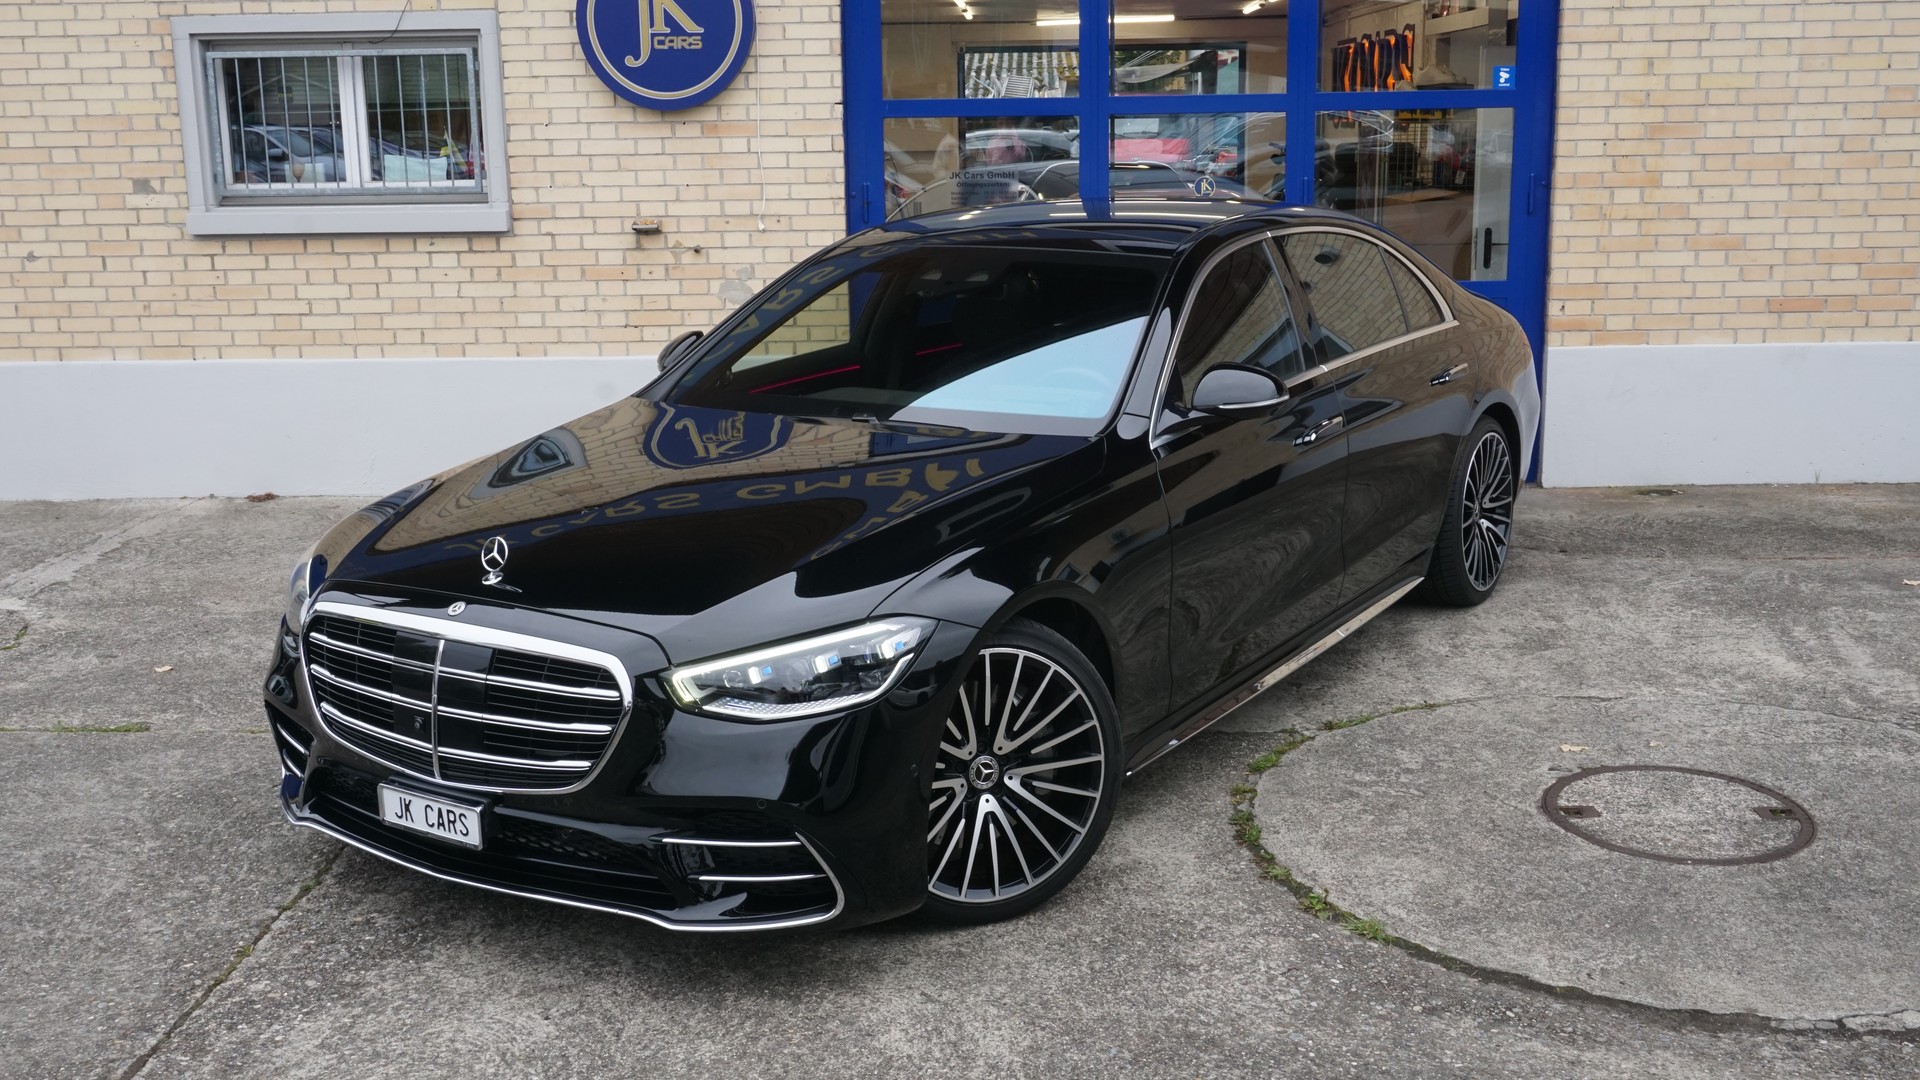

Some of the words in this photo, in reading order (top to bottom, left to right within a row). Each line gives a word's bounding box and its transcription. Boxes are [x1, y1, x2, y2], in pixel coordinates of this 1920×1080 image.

[653, 36, 703, 49] CARS
[949, 171, 961, 180] JK
[963, 171, 984, 179] Cars
[987, 171, 1015, 179] GmbH
[395, 797, 415, 823] JK
[424, 804, 470, 836] CARS
